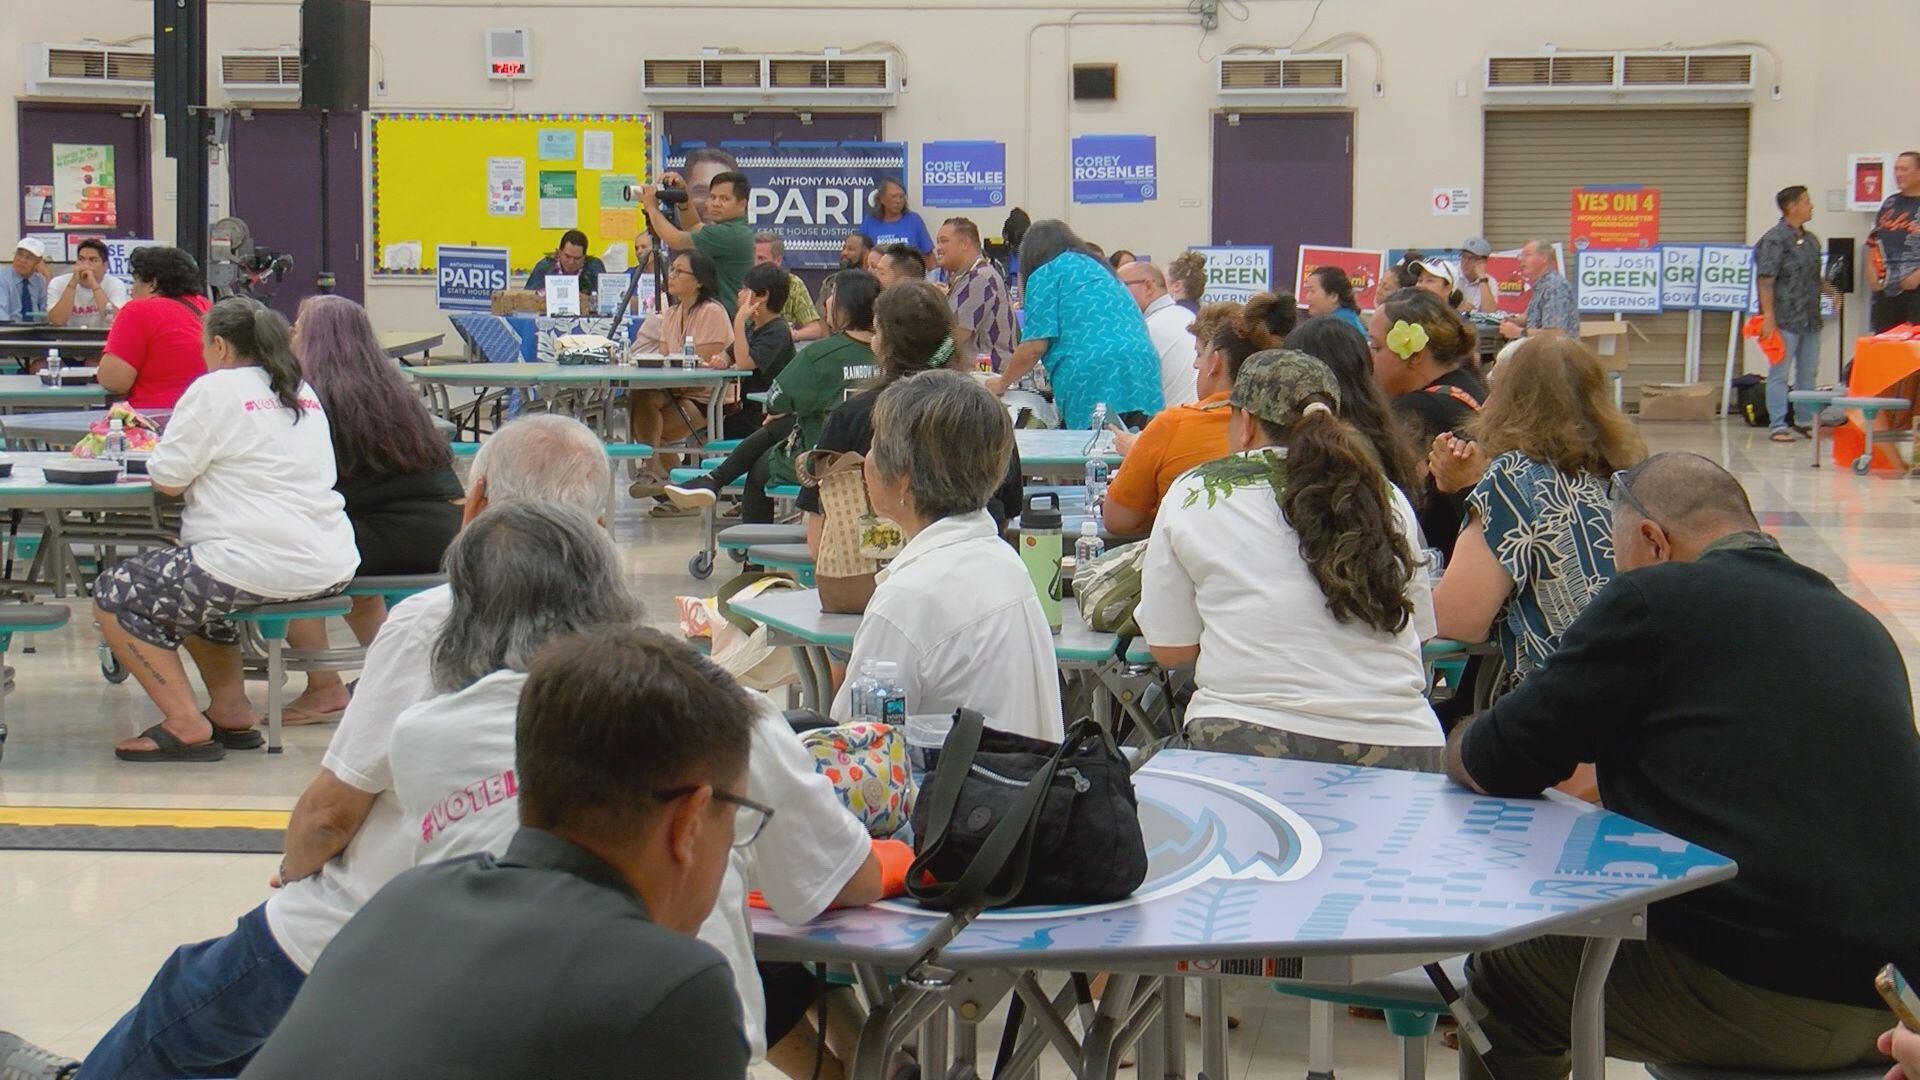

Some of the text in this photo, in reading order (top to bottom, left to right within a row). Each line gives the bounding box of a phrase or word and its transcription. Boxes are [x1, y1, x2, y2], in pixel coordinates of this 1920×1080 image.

[925, 161, 970, 172] COREY
[1074, 155, 1121, 167] COREY
[925, 171, 1003, 184] ROSENLEE
[1075, 165, 1154, 179] ROSENLEE
[768, 177, 875, 186] ANTHONY MAKANA
[1577, 194, 1654, 211] YES ON 4
[1225, 253, 1264, 266] Josh
[1585, 255, 1654, 269] Dr. Josh
[1668, 251, 1692, 264] Dr.
[1709, 251, 1733, 264] Dr.
[441, 267, 505, 290] PARIS
[1582, 271, 1656, 287] GREEN
[447, 287, 466, 295] STATE
[1580, 296, 1656, 306] GOVERNOR
[843, 365, 873, 381] RAINBOW
